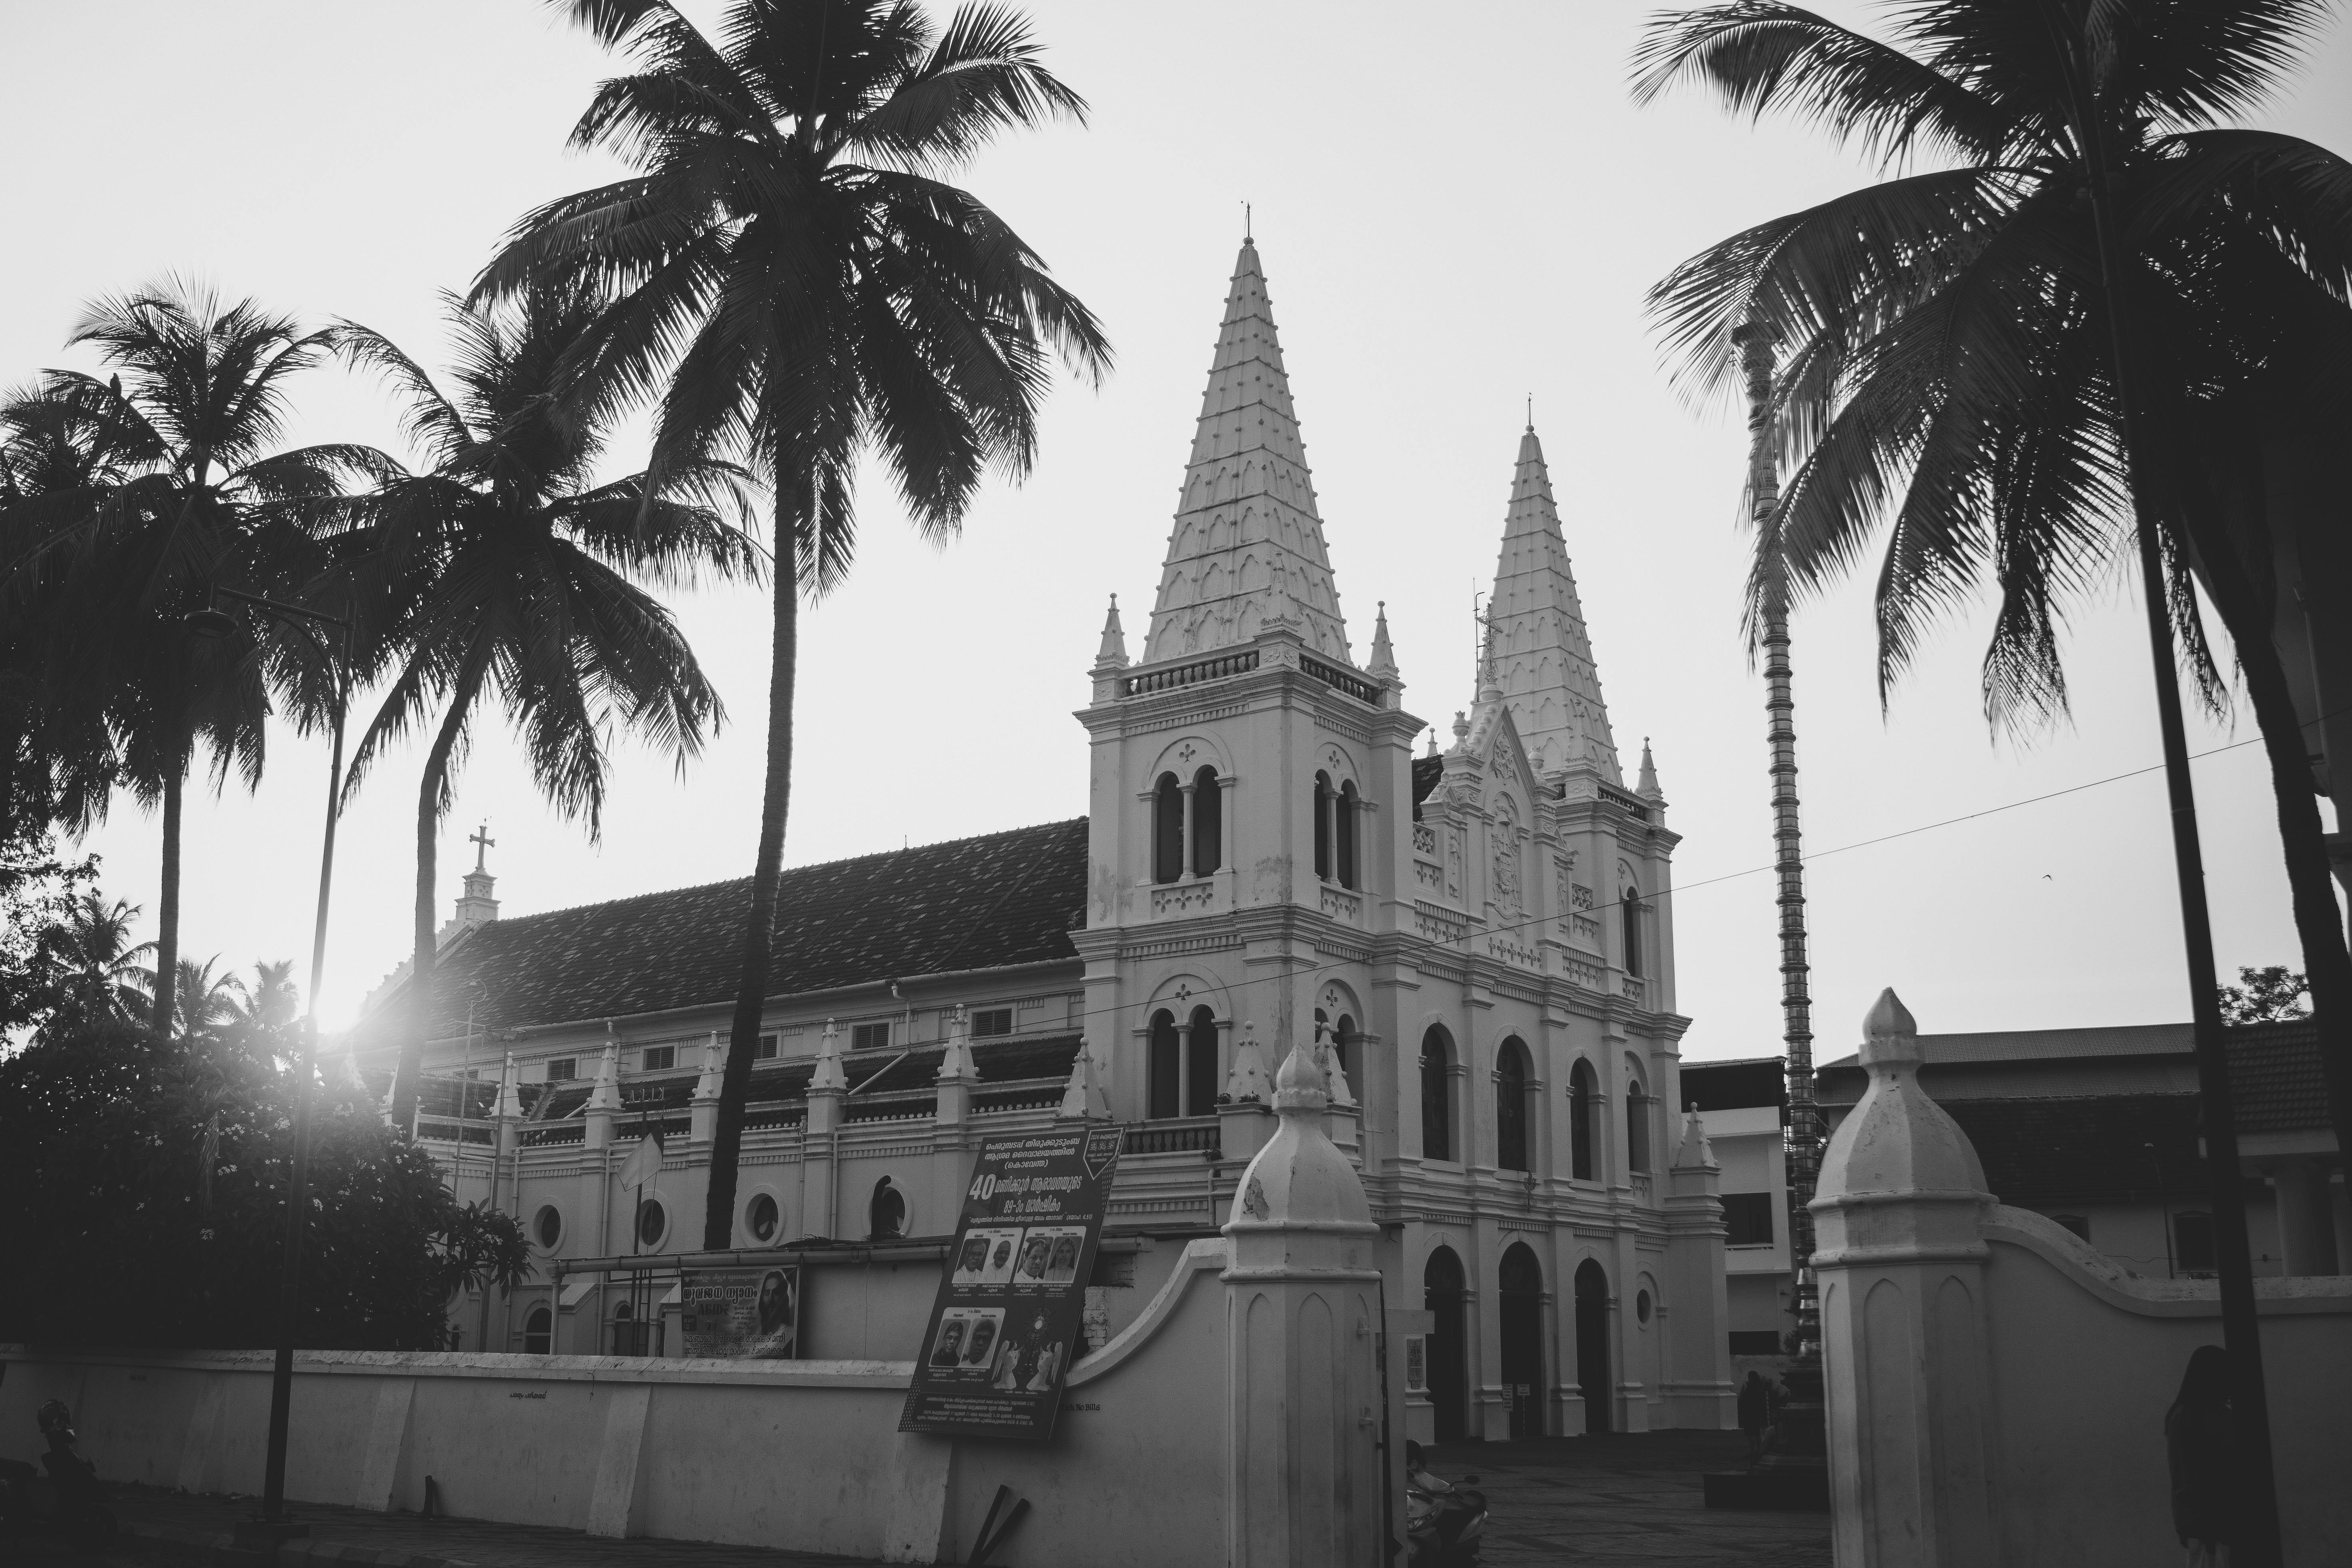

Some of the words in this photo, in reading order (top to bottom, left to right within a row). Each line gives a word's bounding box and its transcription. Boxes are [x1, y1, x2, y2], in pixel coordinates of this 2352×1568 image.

[986, 1140, 1025, 1150] പെരുമ്പടപ്പ്
[1025, 1138, 1080, 1148] തിരുക്കുടുംബ
[984, 1152, 1010, 1161] ആശ്രമ
[1012, 1147, 1075, 1159] ദൈവാലയത്തിൽ
[1004, 1159, 1048, 1170] (കൊവേന്ത)
[969, 1173, 996, 1200] 40
[994, 1175, 1030, 1195] മണിക്കൂർ
[1030, 1176, 1082, 1194] ആരാധനയുടെ
[1025, 1194, 1061, 1212] വാർഷികം
[683, 1286, 723, 1306] യുവജന
[726, 1286, 758, 1304] ധ്യാനം
[716, 1333, 724, 1343] 23
[726, 1333, 745, 1345] വെള്ളി
[745, 1332, 766, 1343] രാവിലെ
[702, 1344, 711, 1355] 27
[711, 1347, 728, 1358] ചൊവ്വ
[730, 1345, 751, 1355] രാവിലെ
